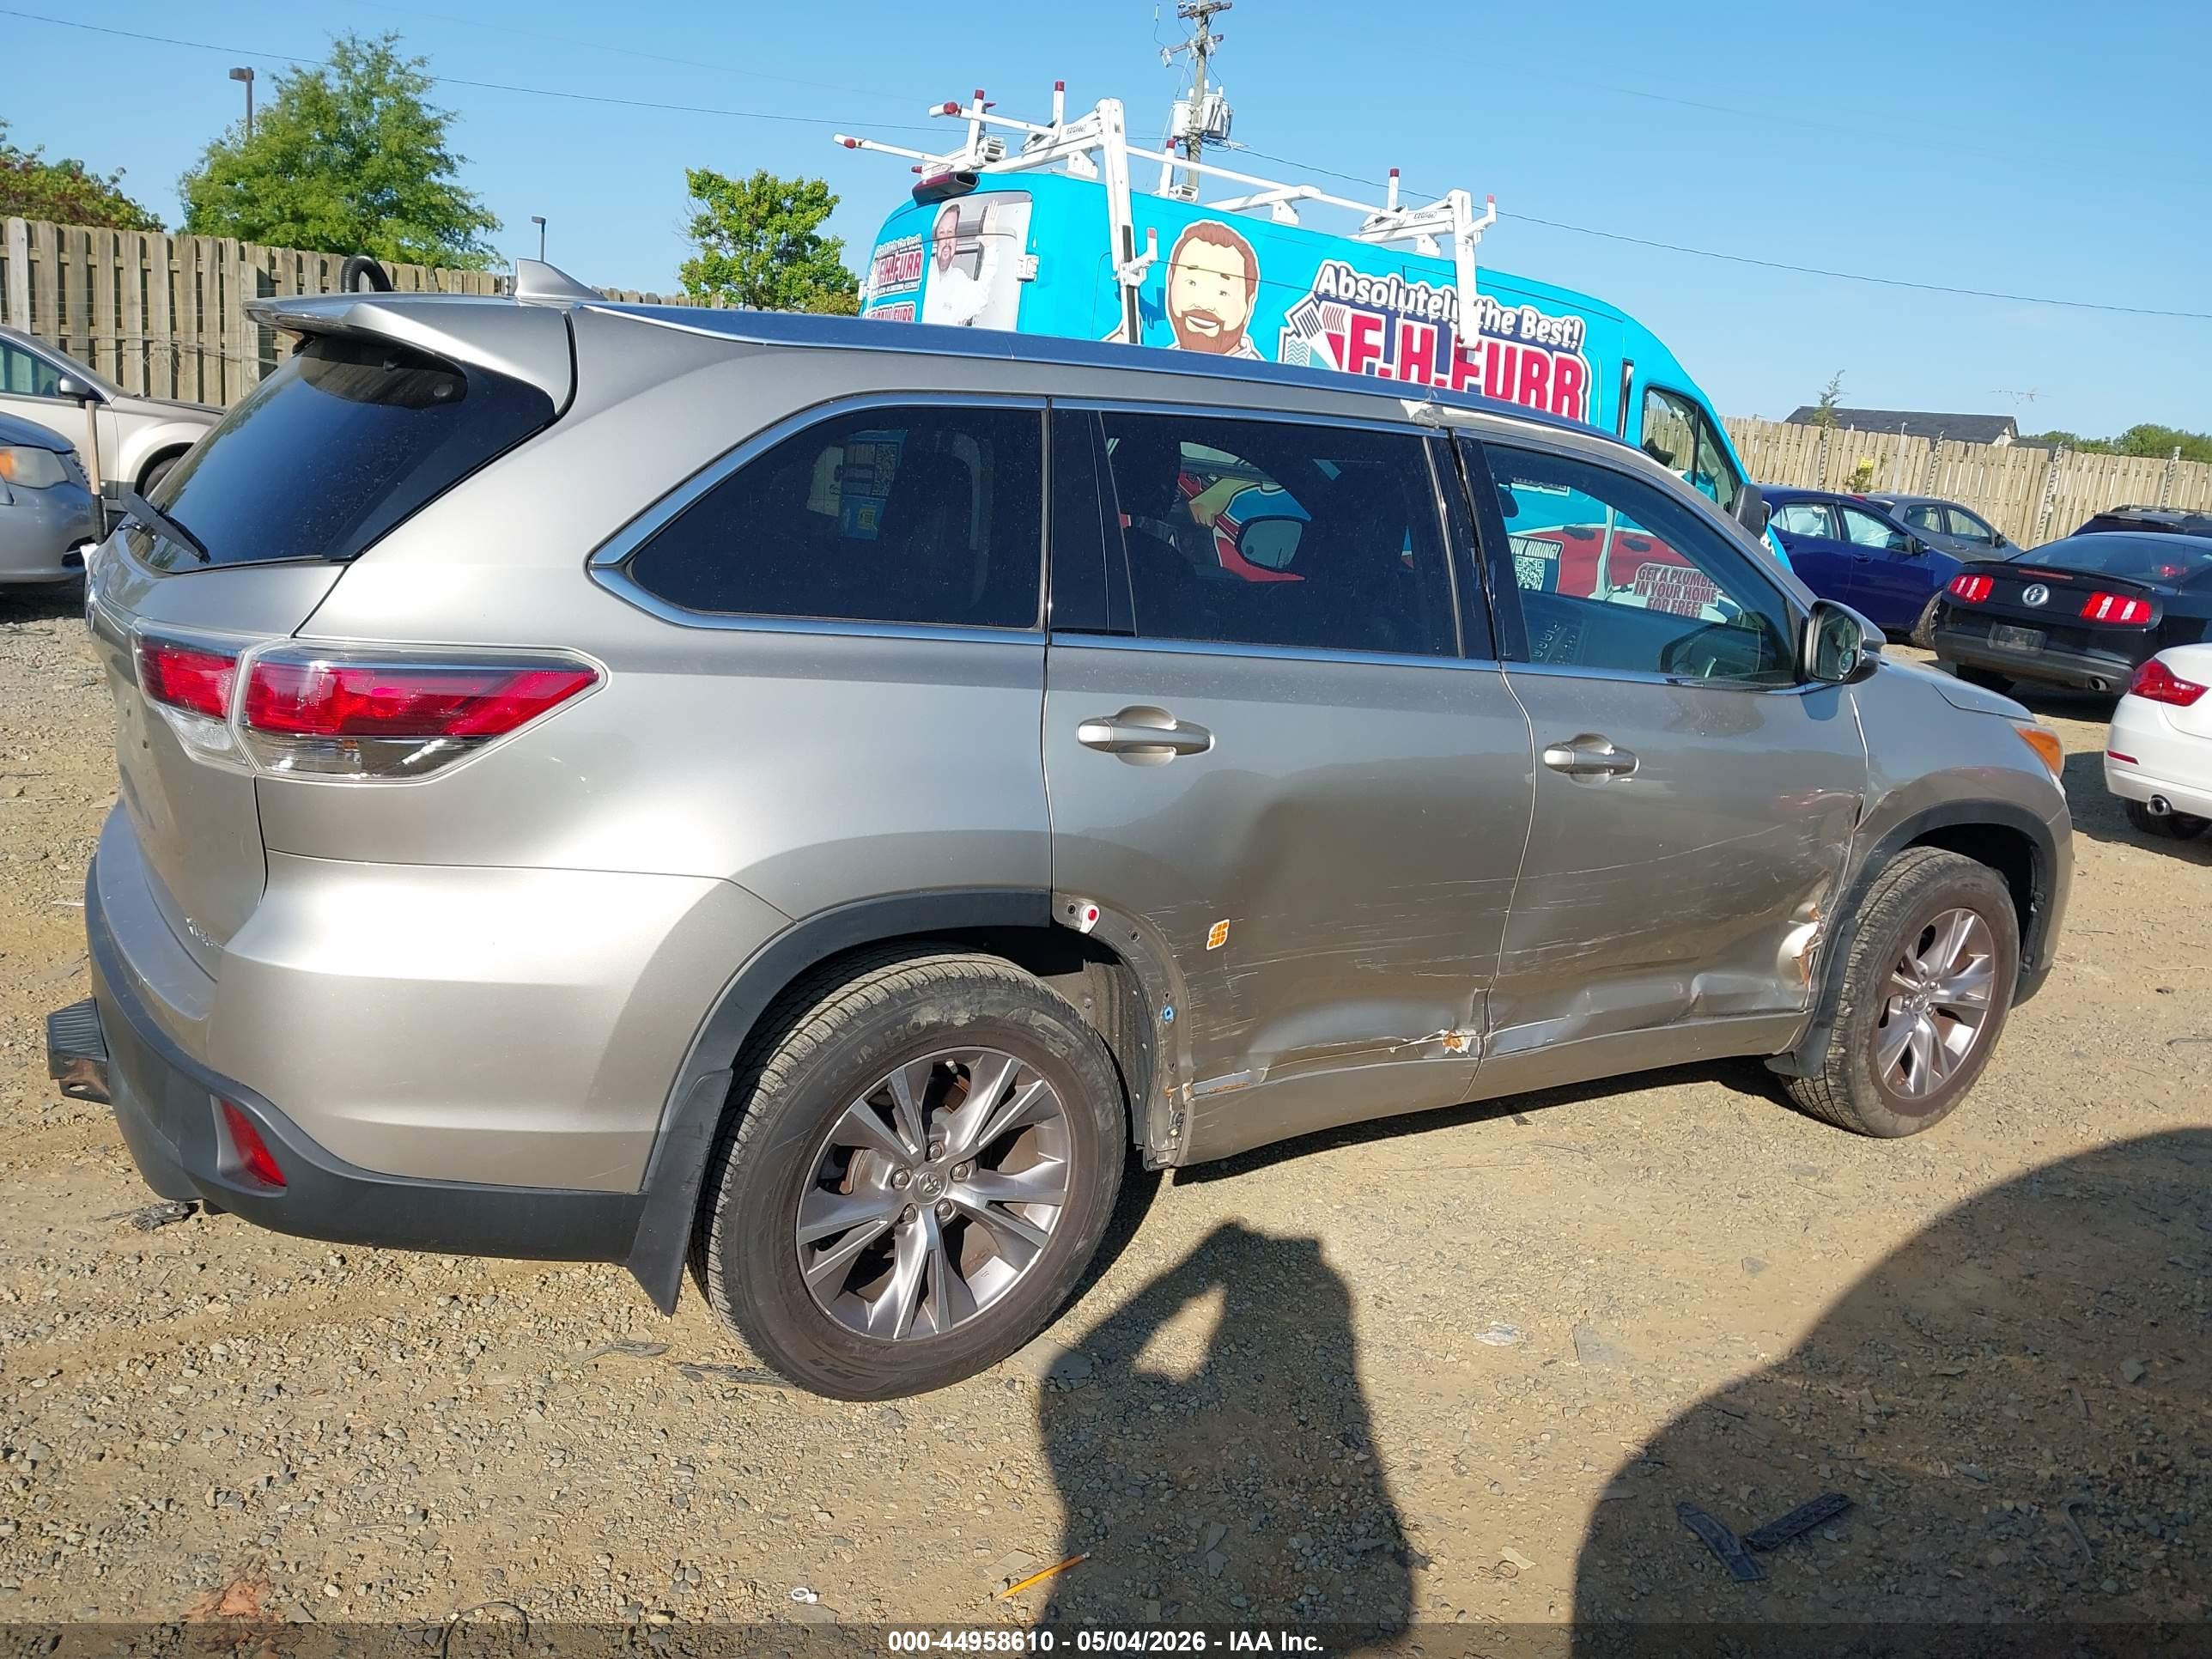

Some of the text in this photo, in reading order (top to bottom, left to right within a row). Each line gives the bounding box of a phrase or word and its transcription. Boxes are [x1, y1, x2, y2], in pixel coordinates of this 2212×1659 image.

[1475, 299, 1515, 333] the
[1519, 312, 1583, 349] Best!
[1525, 540, 1561, 560] HIRING!
[1638, 566, 1659, 580] GET
[1658, 568, 1670, 582] A
[1634, 580, 1718, 605] IN YOUR HOME
[1647, 597, 1670, 612] FOR
